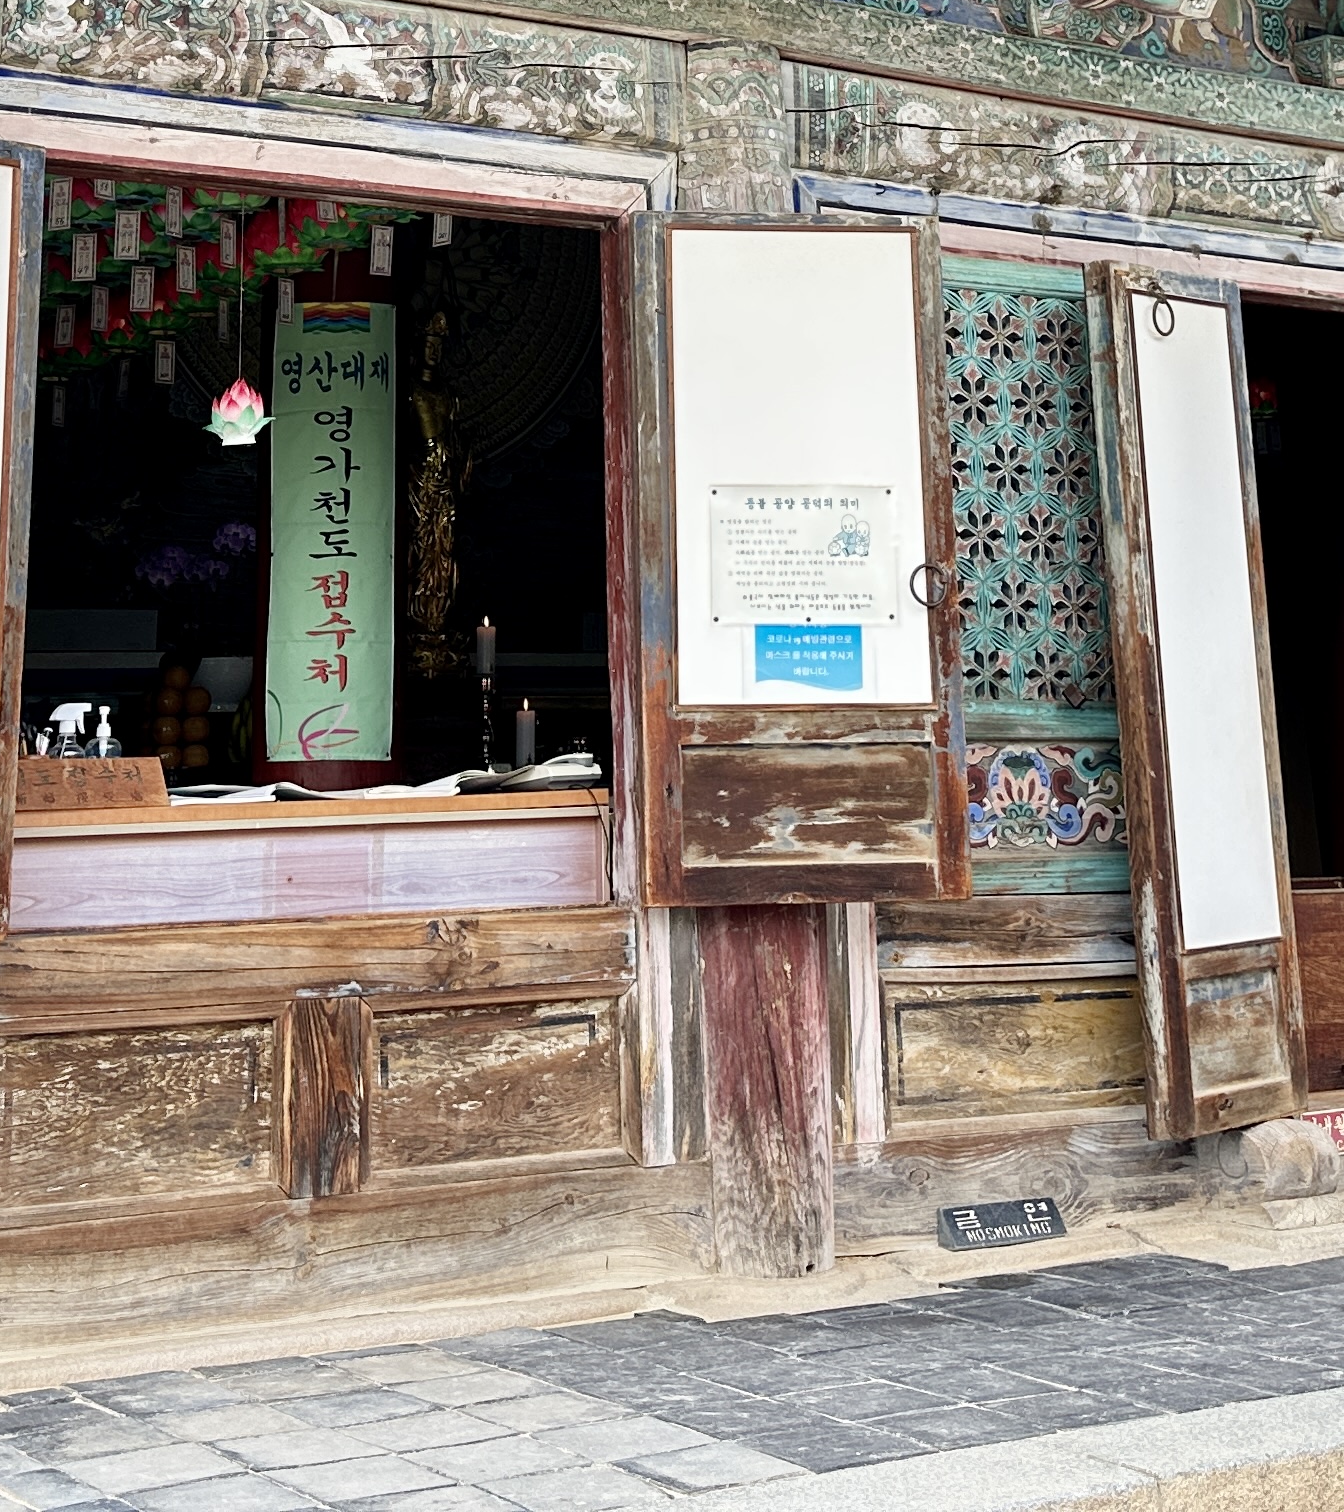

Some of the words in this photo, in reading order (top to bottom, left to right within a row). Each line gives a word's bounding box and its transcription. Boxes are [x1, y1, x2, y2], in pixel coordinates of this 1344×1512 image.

[281, 351, 391, 395] 영산대재
[309, 406, 361, 561] 영가천도
[840, 498, 859, 510] 의미
[305, 571, 357, 692] 접수처
